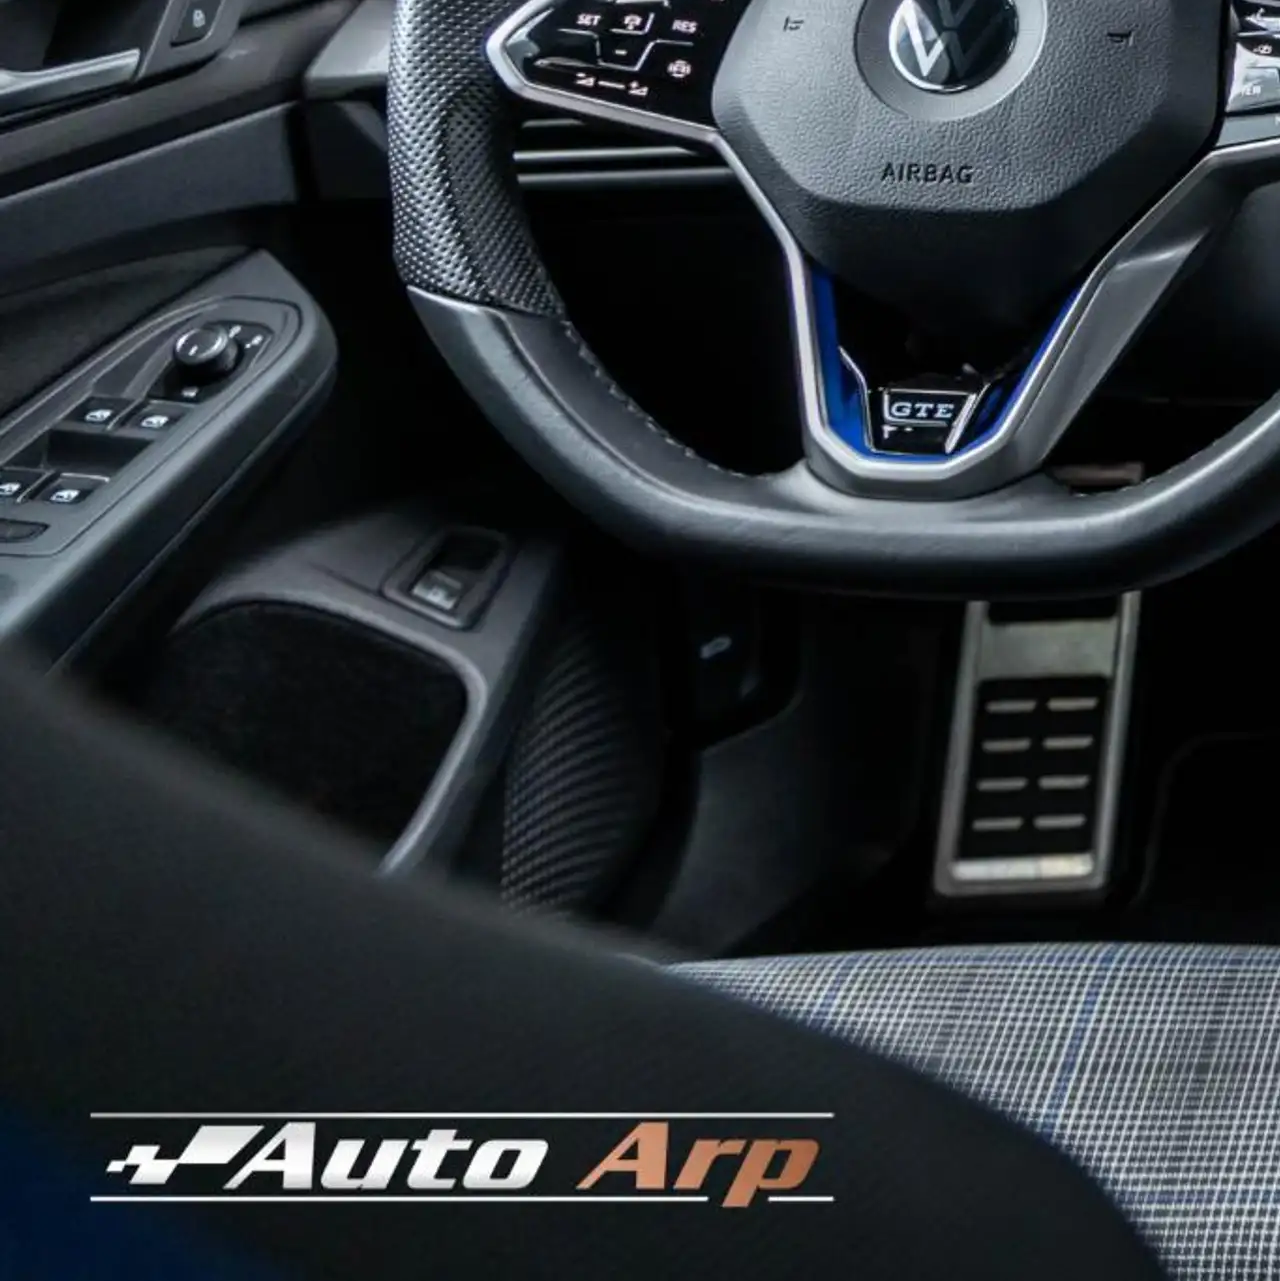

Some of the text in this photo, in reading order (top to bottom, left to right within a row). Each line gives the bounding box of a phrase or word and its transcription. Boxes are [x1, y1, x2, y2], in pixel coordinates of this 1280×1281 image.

[576, 13, 601, 26] SET
[671, 20, 698, 34] RES
[880, 162, 974, 184] AIRBAG
[890, 402, 955, 419] GTE
